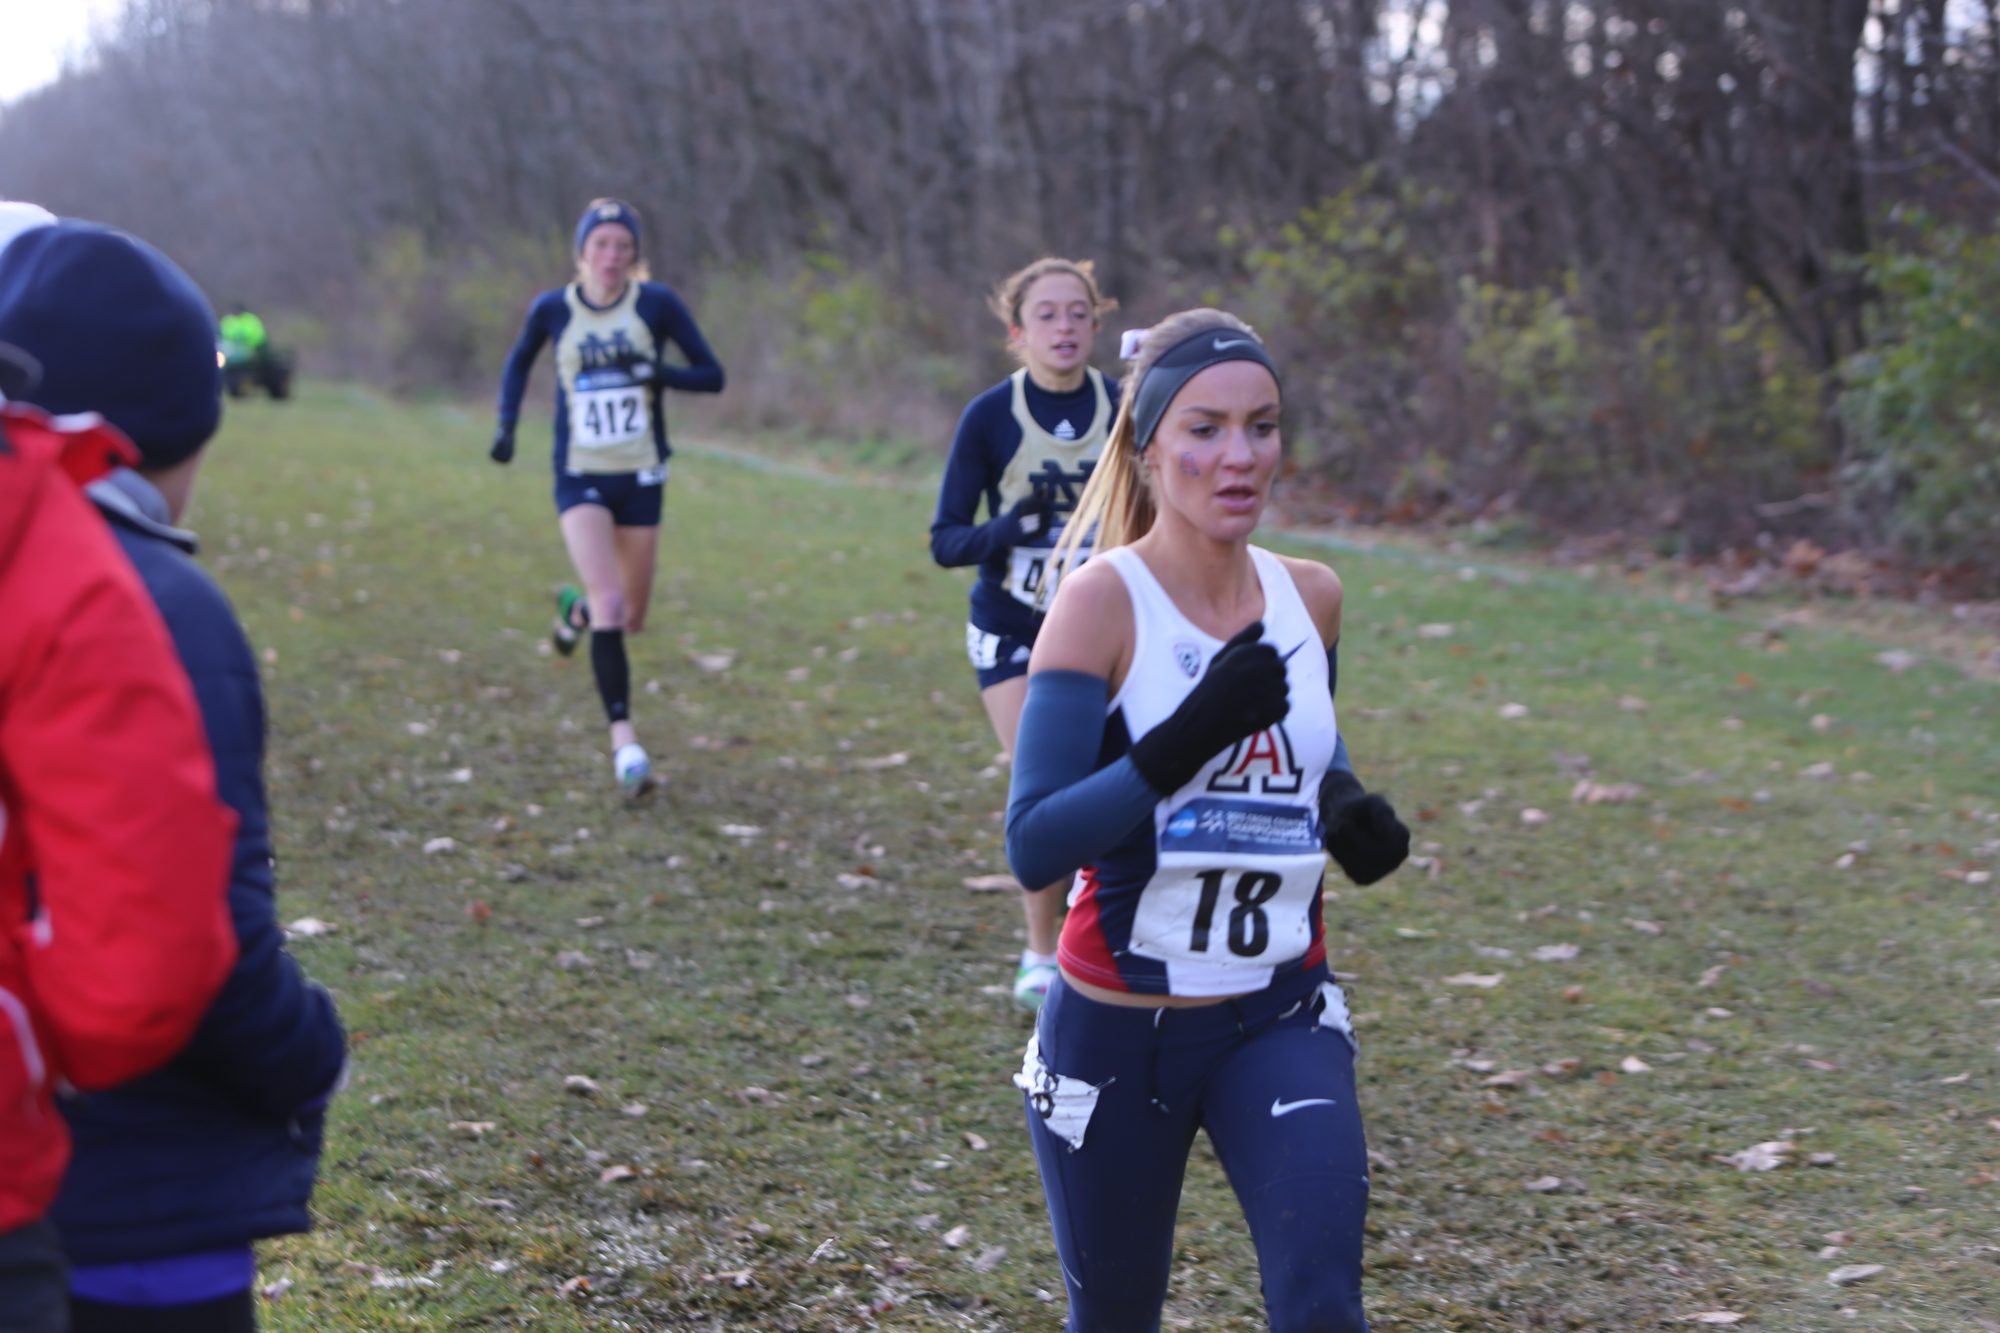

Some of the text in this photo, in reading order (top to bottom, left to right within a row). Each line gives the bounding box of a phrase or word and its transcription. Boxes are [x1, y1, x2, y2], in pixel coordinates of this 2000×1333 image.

[585, 396, 639, 436] 412
[1206, 719, 1303, 794] A
[1189, 867, 1283, 958] 18
